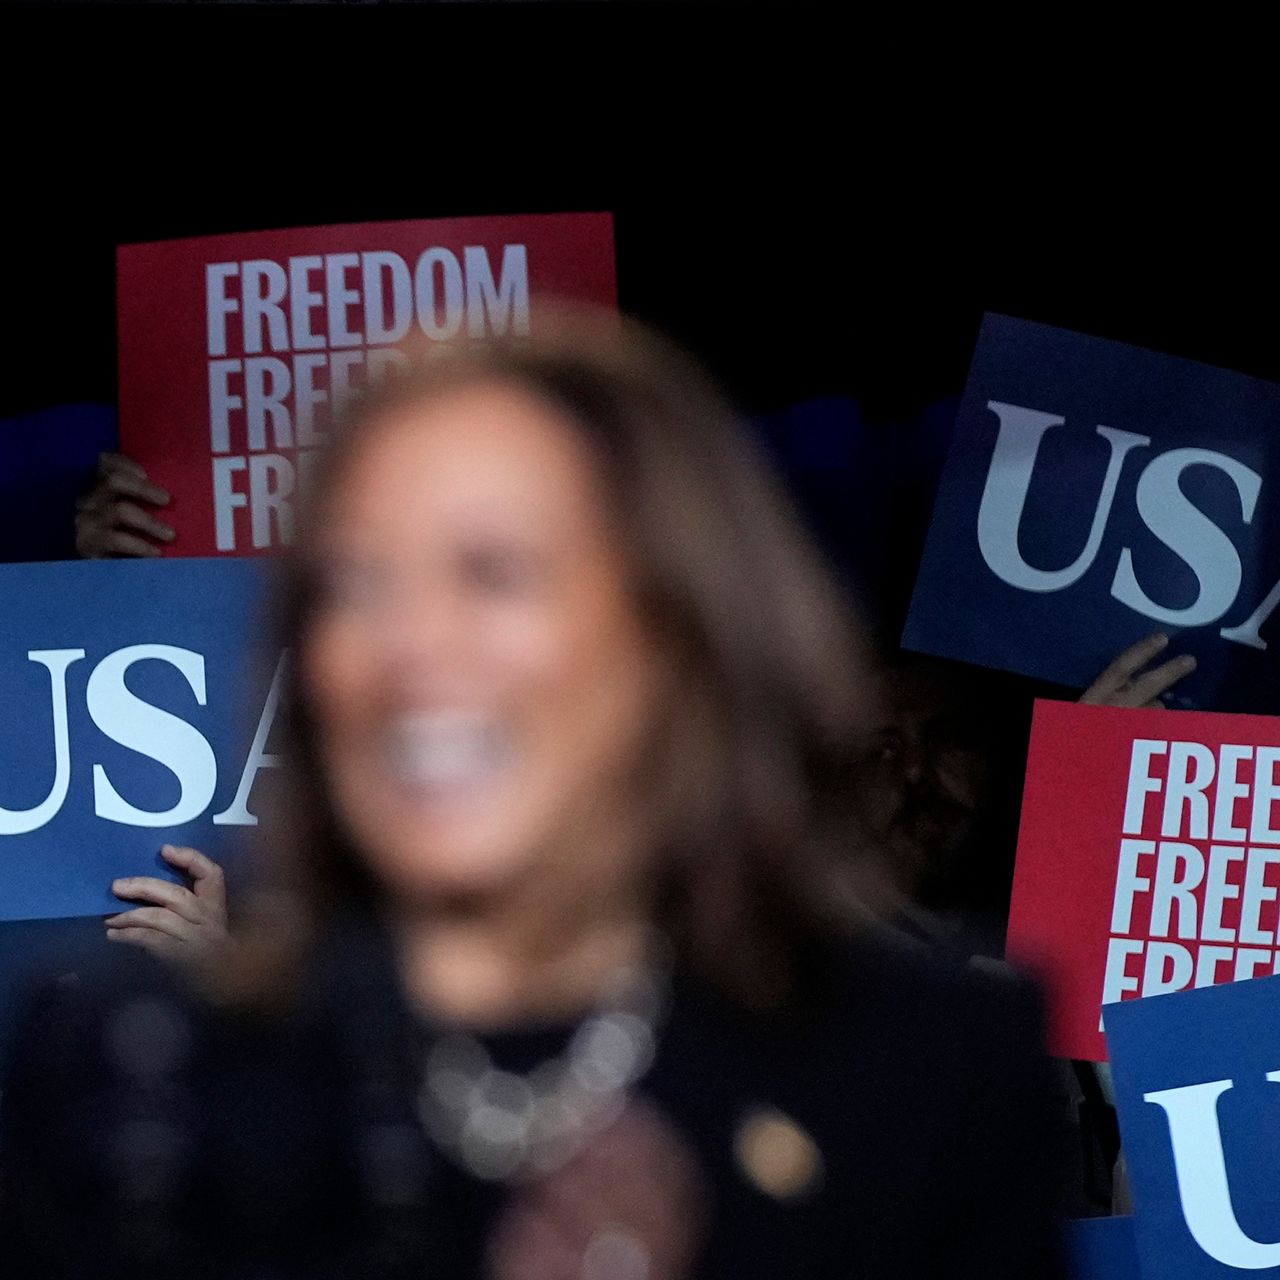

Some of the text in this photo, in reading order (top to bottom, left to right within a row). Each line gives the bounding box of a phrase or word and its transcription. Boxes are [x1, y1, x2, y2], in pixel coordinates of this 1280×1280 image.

[206, 243, 531, 357] FREEDOM
[976, 399, 1280, 651] US
[1109, 838, 1280, 945] FREE
